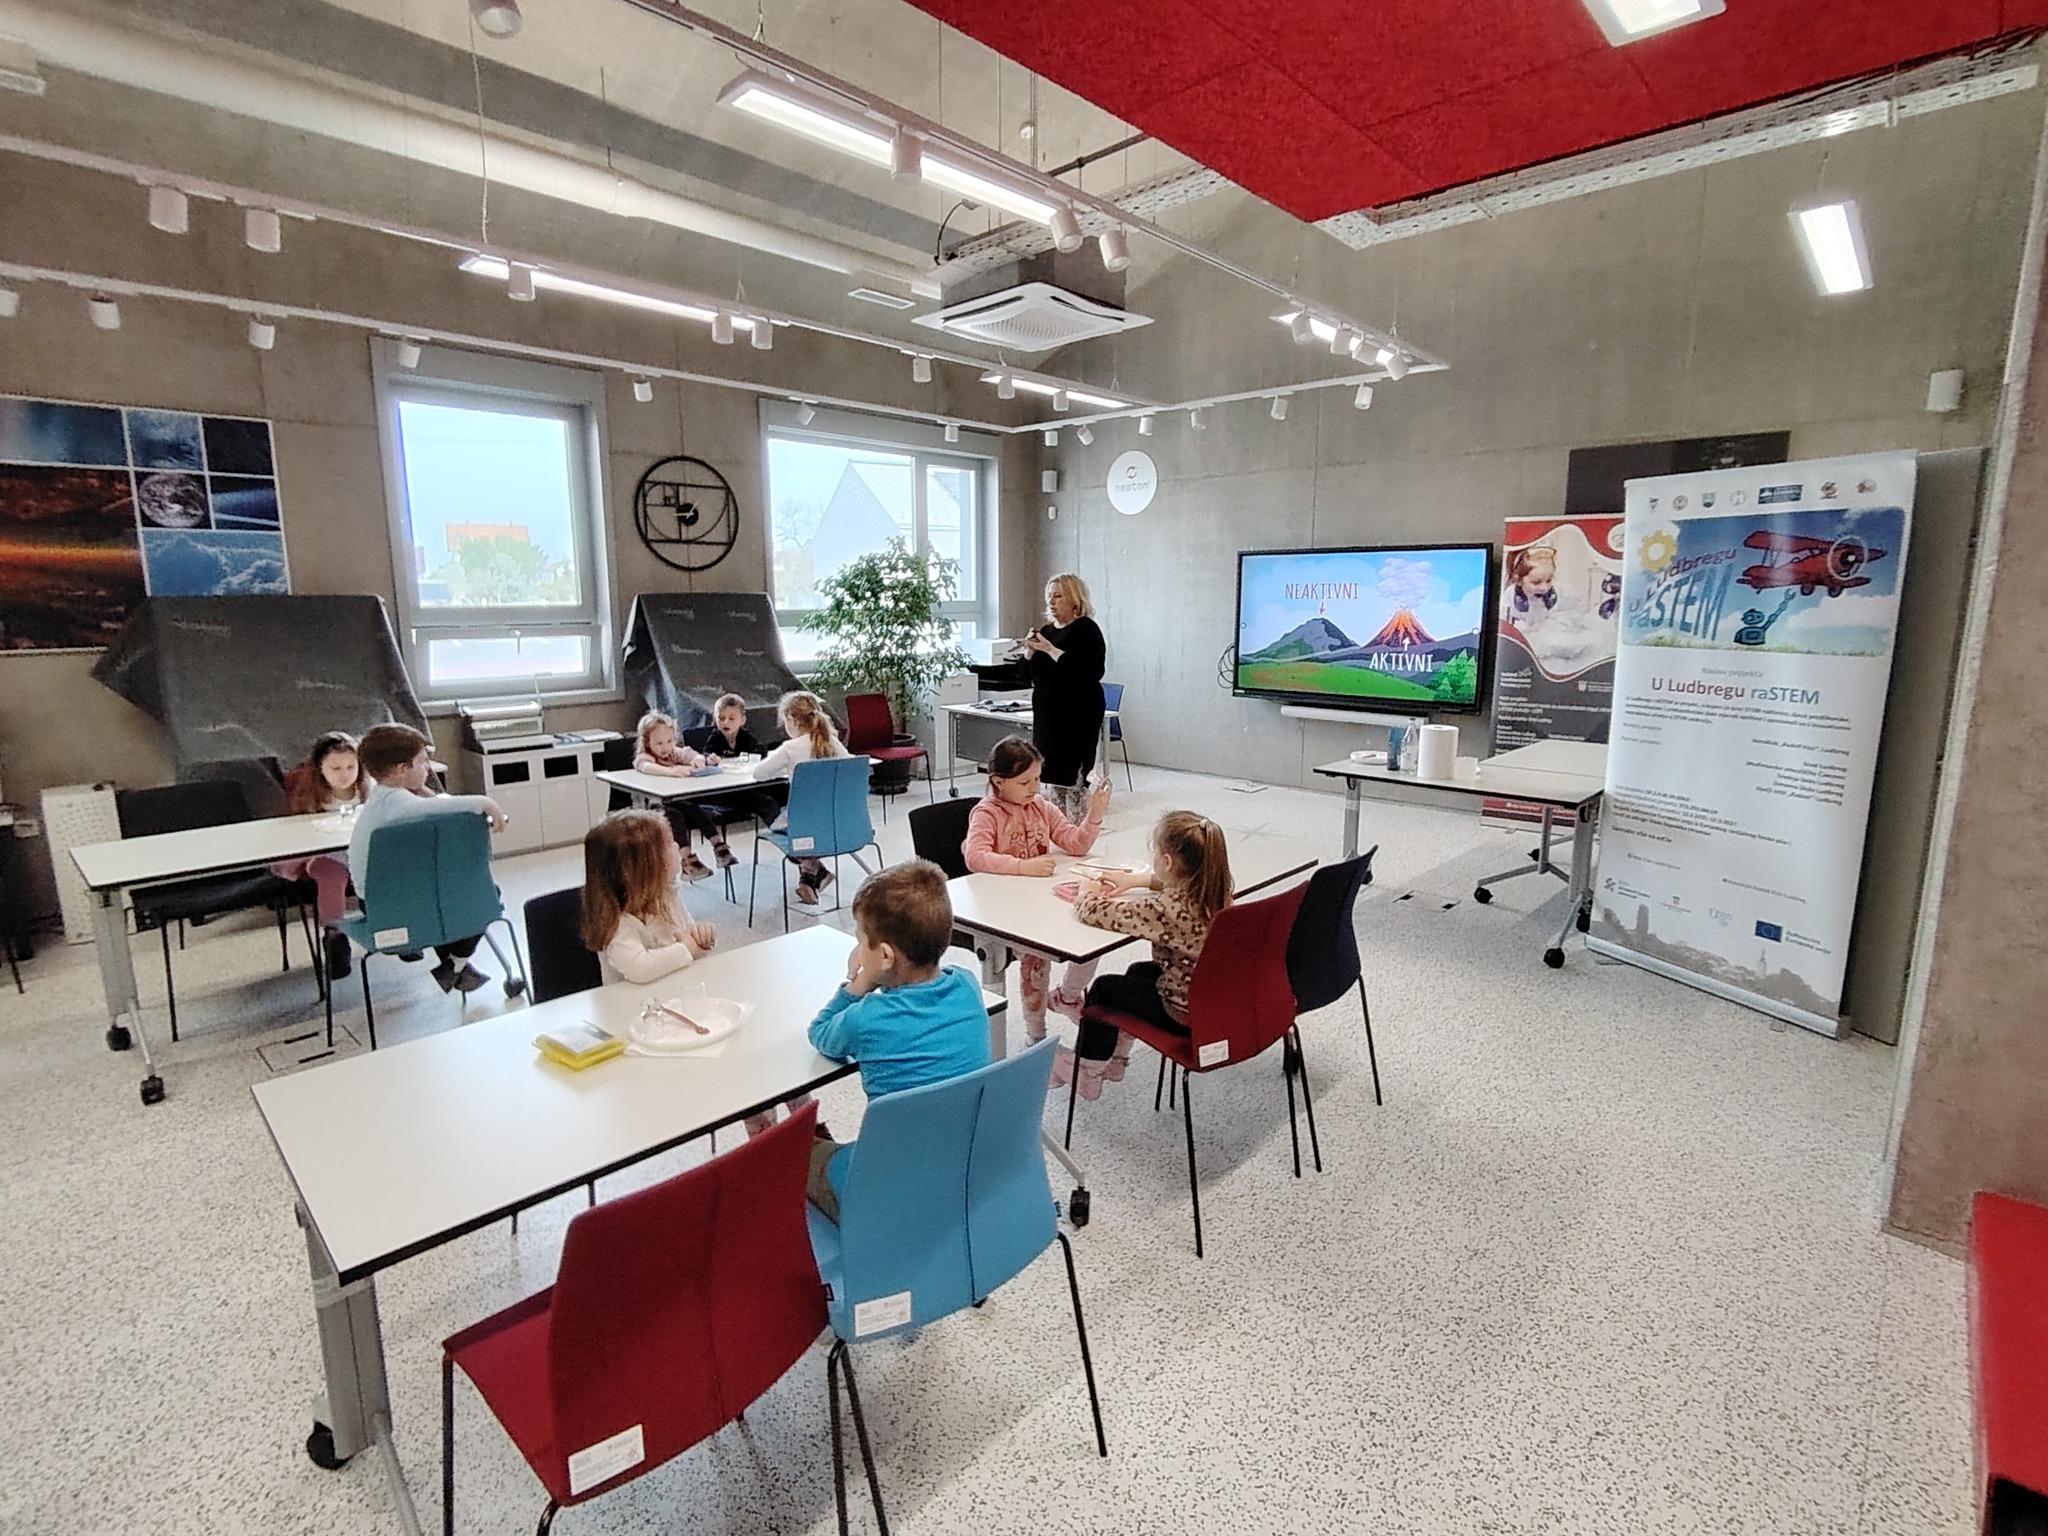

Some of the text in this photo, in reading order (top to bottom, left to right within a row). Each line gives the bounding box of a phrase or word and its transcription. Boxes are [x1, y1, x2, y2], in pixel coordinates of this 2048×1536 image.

[1285, 582, 1359, 600] NEAKTIVNI
[1369, 651, 1434, 673] AKTIVNI
[1652, 677, 1820, 705] U Ludbregu raSTEM
